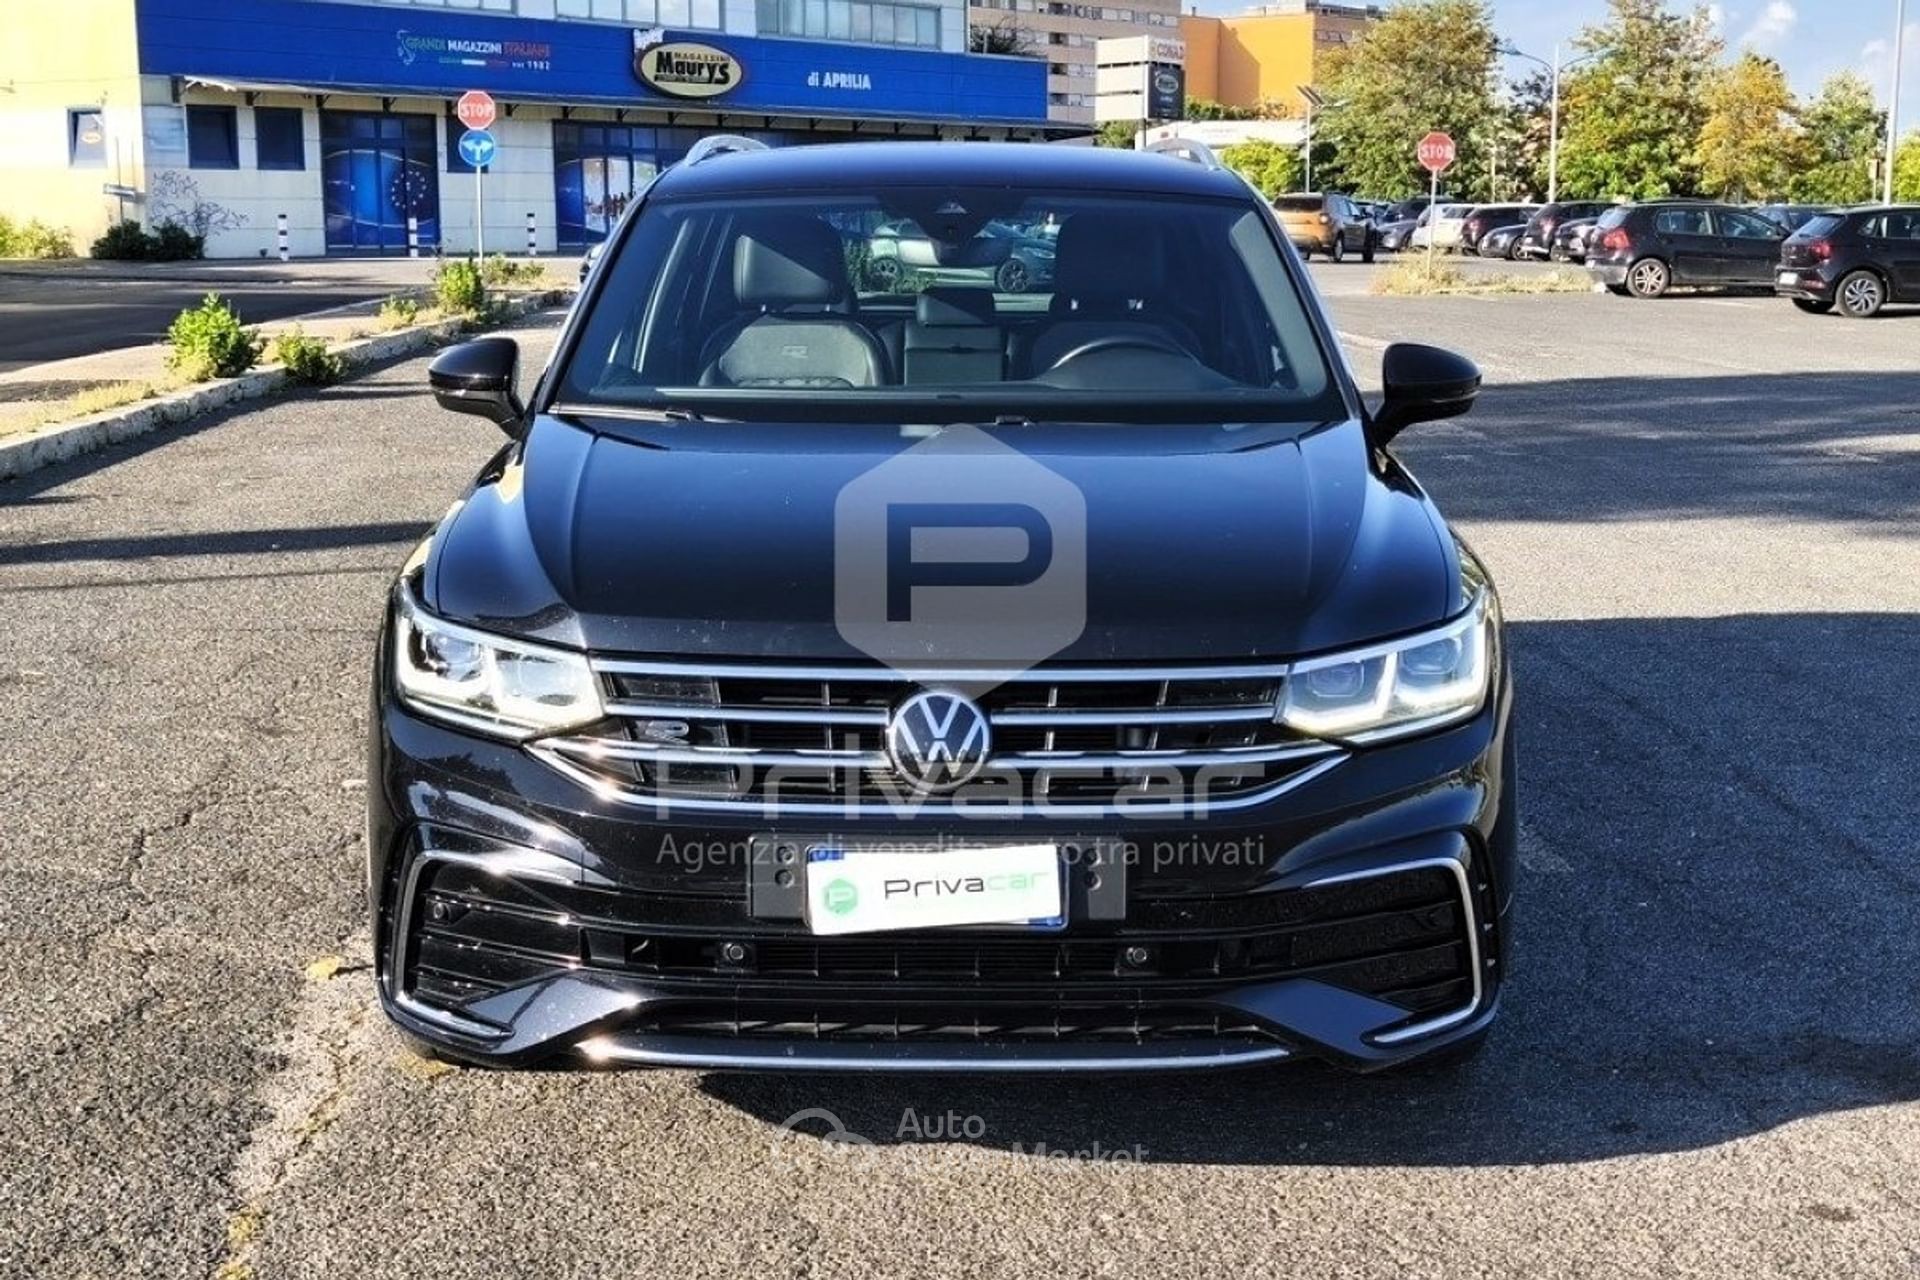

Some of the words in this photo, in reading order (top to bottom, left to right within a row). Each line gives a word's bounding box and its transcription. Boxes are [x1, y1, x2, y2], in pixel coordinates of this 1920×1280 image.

[447, 40, 502, 55] MAGAZZINI
[807, 72, 819, 88] di
[823, 72, 872, 90] APRILIA
[460, 103, 494, 118] STOP
[1420, 144, 1454, 159] STOP
[884, 871, 1049, 900] Privacar
